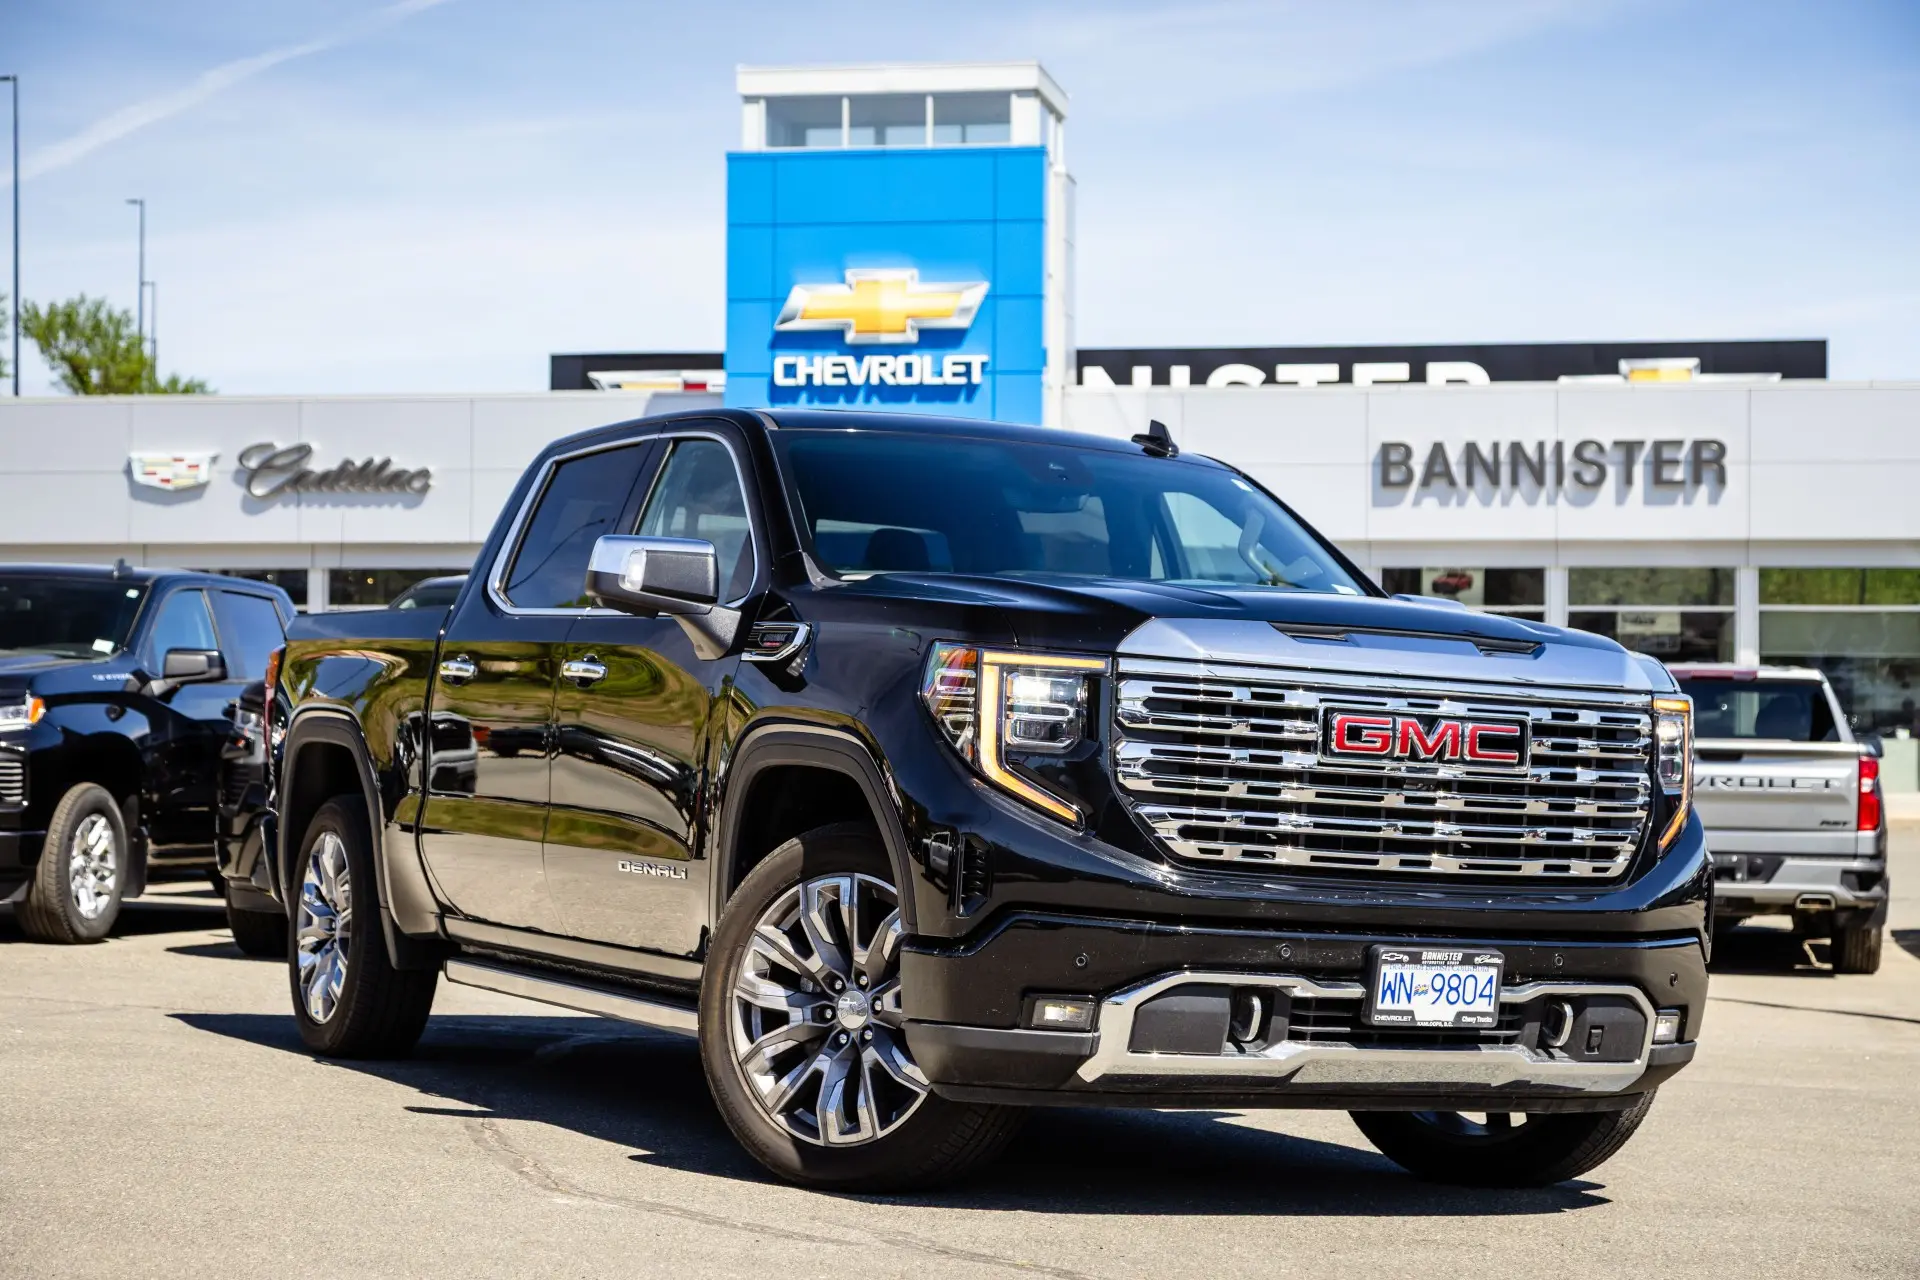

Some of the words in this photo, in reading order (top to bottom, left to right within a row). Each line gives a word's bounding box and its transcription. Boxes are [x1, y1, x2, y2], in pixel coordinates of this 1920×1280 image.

[773, 354, 989, 386] CHEVROLET
[238, 442, 431, 498] Cadillac
[1380, 440, 1727, 488] BANNISTER
[1331, 713, 1521, 764] GMC
[618, 860, 688, 880] DENALI
[1422, 952, 1463, 961] BANNISTER
[1381, 972, 1414, 1004] WN
[1431, 973, 1494, 1006] 9804
[1374, 1014, 1412, 1022] CHEVROLET
